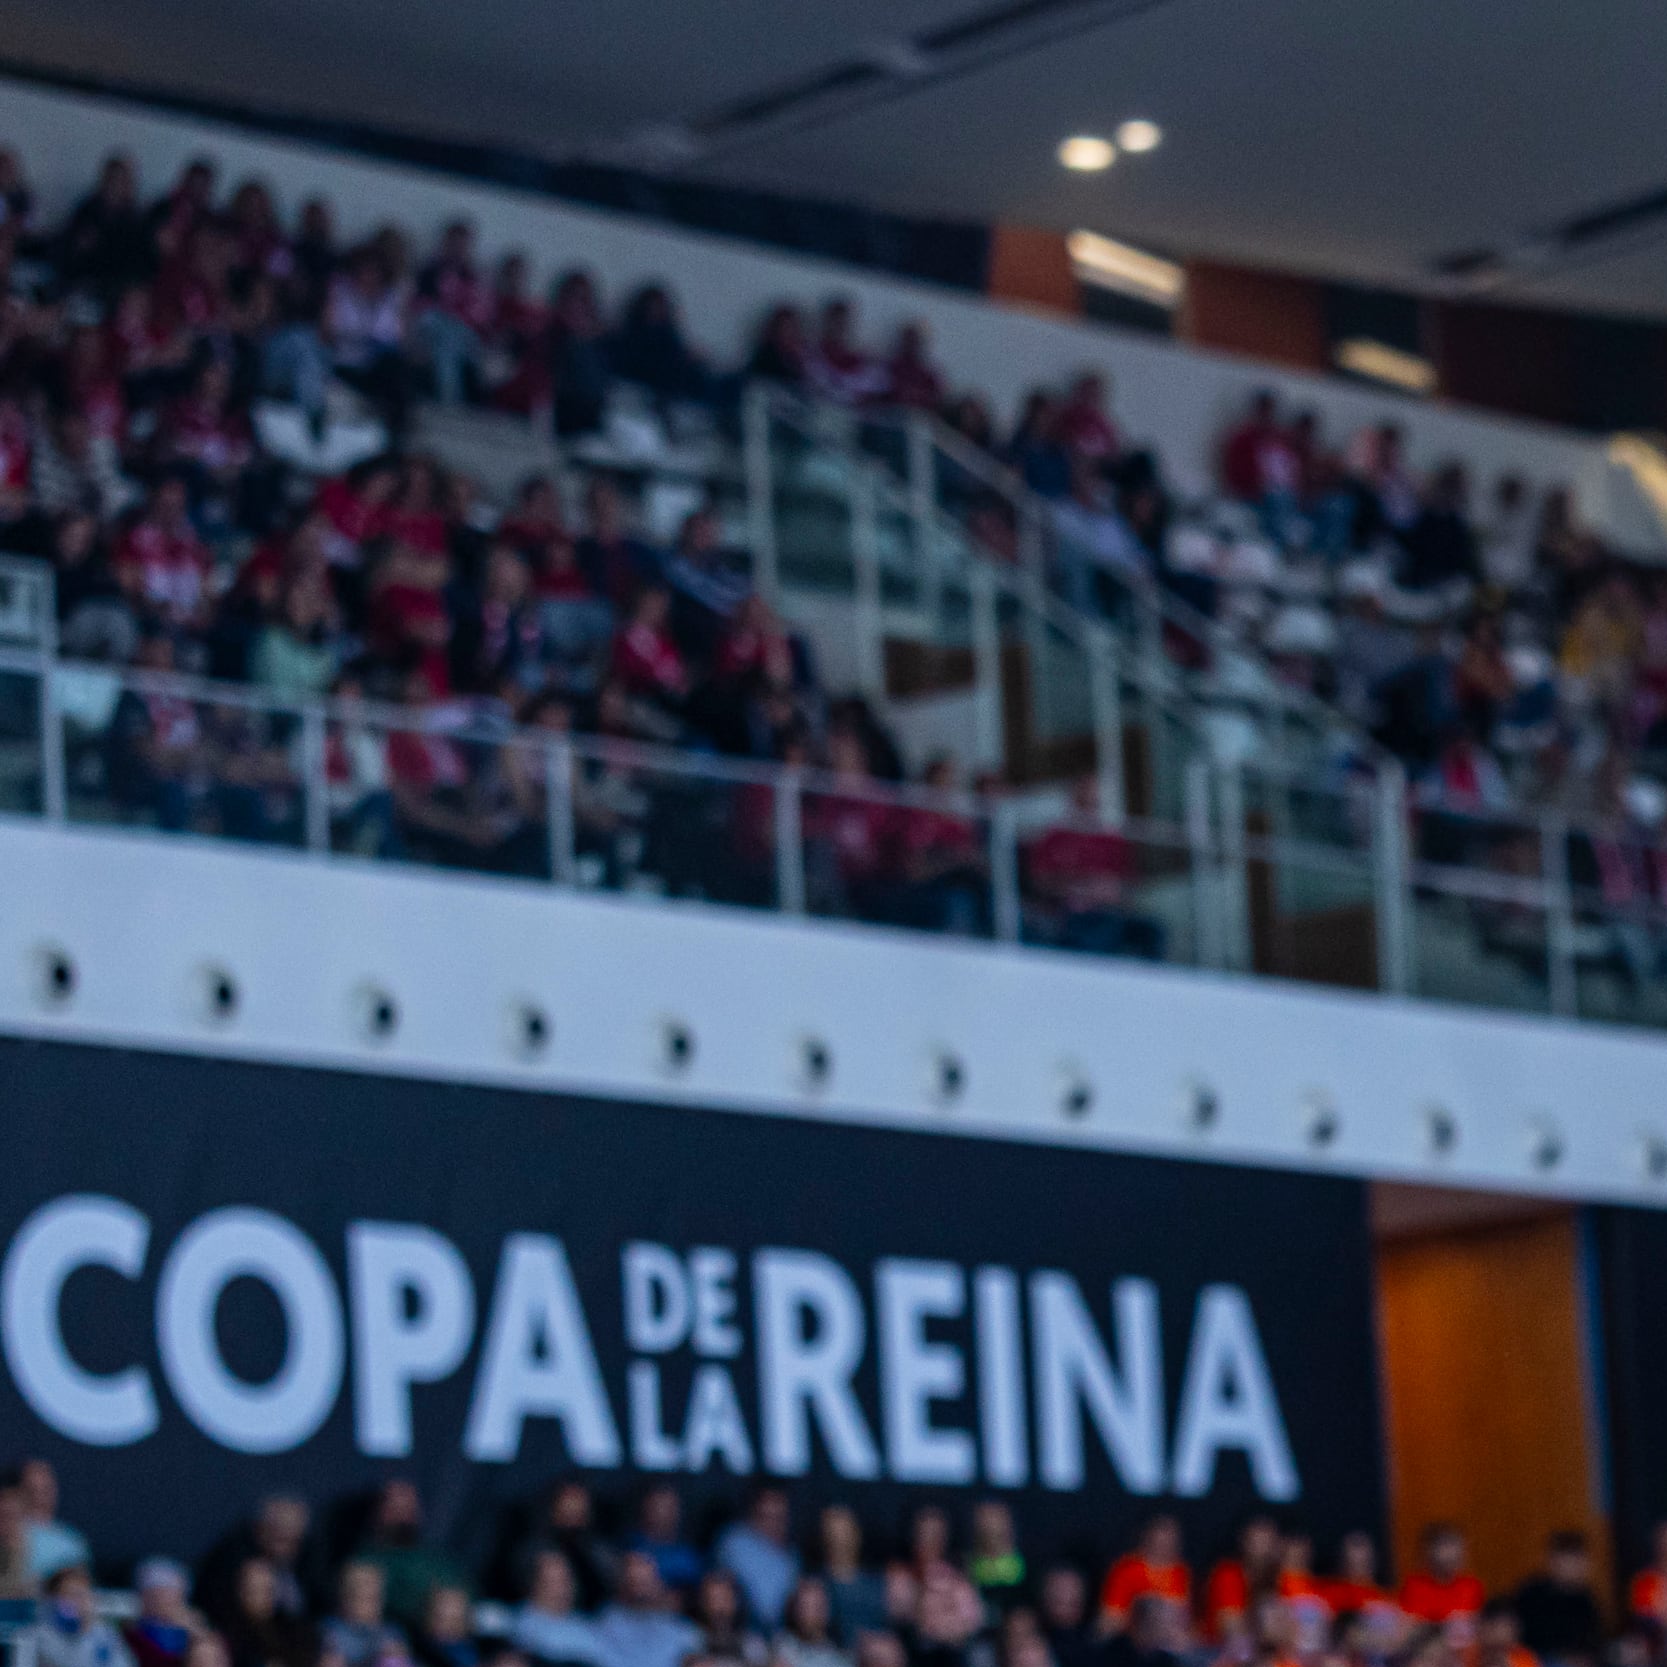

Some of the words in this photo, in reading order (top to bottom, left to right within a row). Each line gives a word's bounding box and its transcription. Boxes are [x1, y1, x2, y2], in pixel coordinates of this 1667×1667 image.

[3, 1192, 622, 1468] COPA
[621, 1240, 742, 1357] DE
[752, 1245, 1301, 1503] REINA
[628, 1360, 752, 1474] LA
